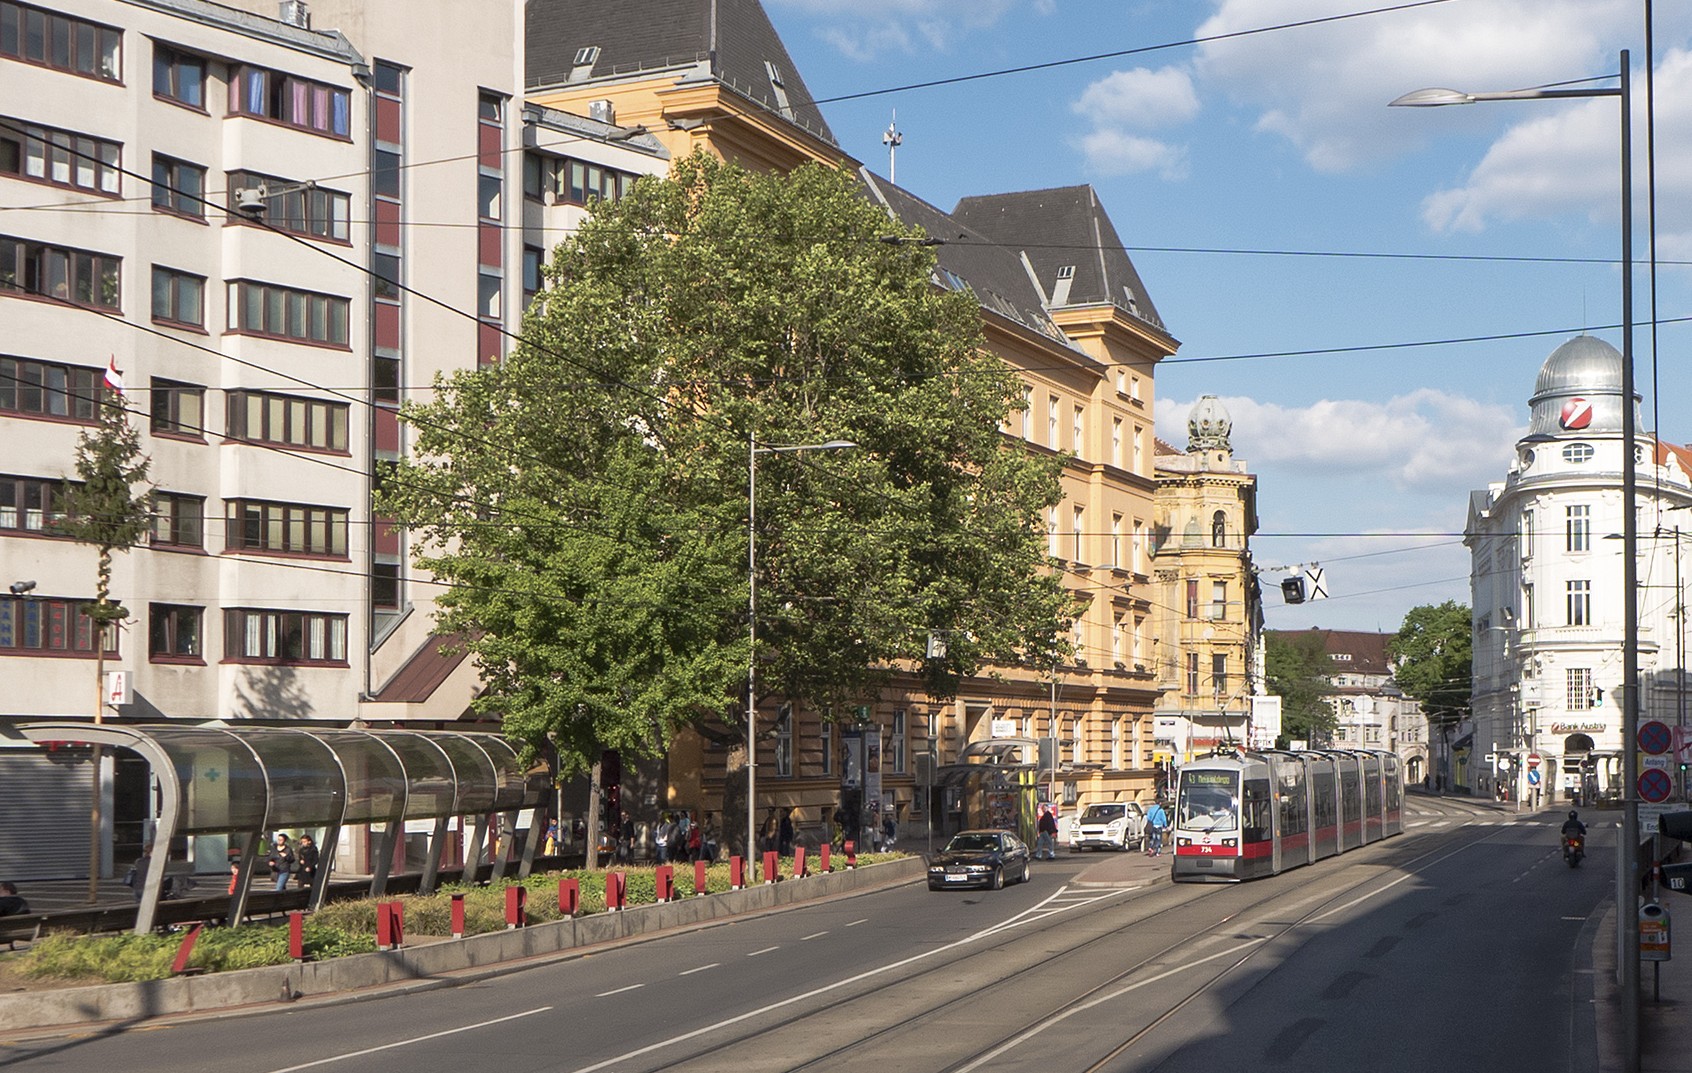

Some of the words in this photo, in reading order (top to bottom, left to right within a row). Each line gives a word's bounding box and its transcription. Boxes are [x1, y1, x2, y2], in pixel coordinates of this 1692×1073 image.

[1560, 722, 1579, 731] Bank
[1581, 722, 1606, 731] Austria
[1644, 758, 1665, 767] Anfang
